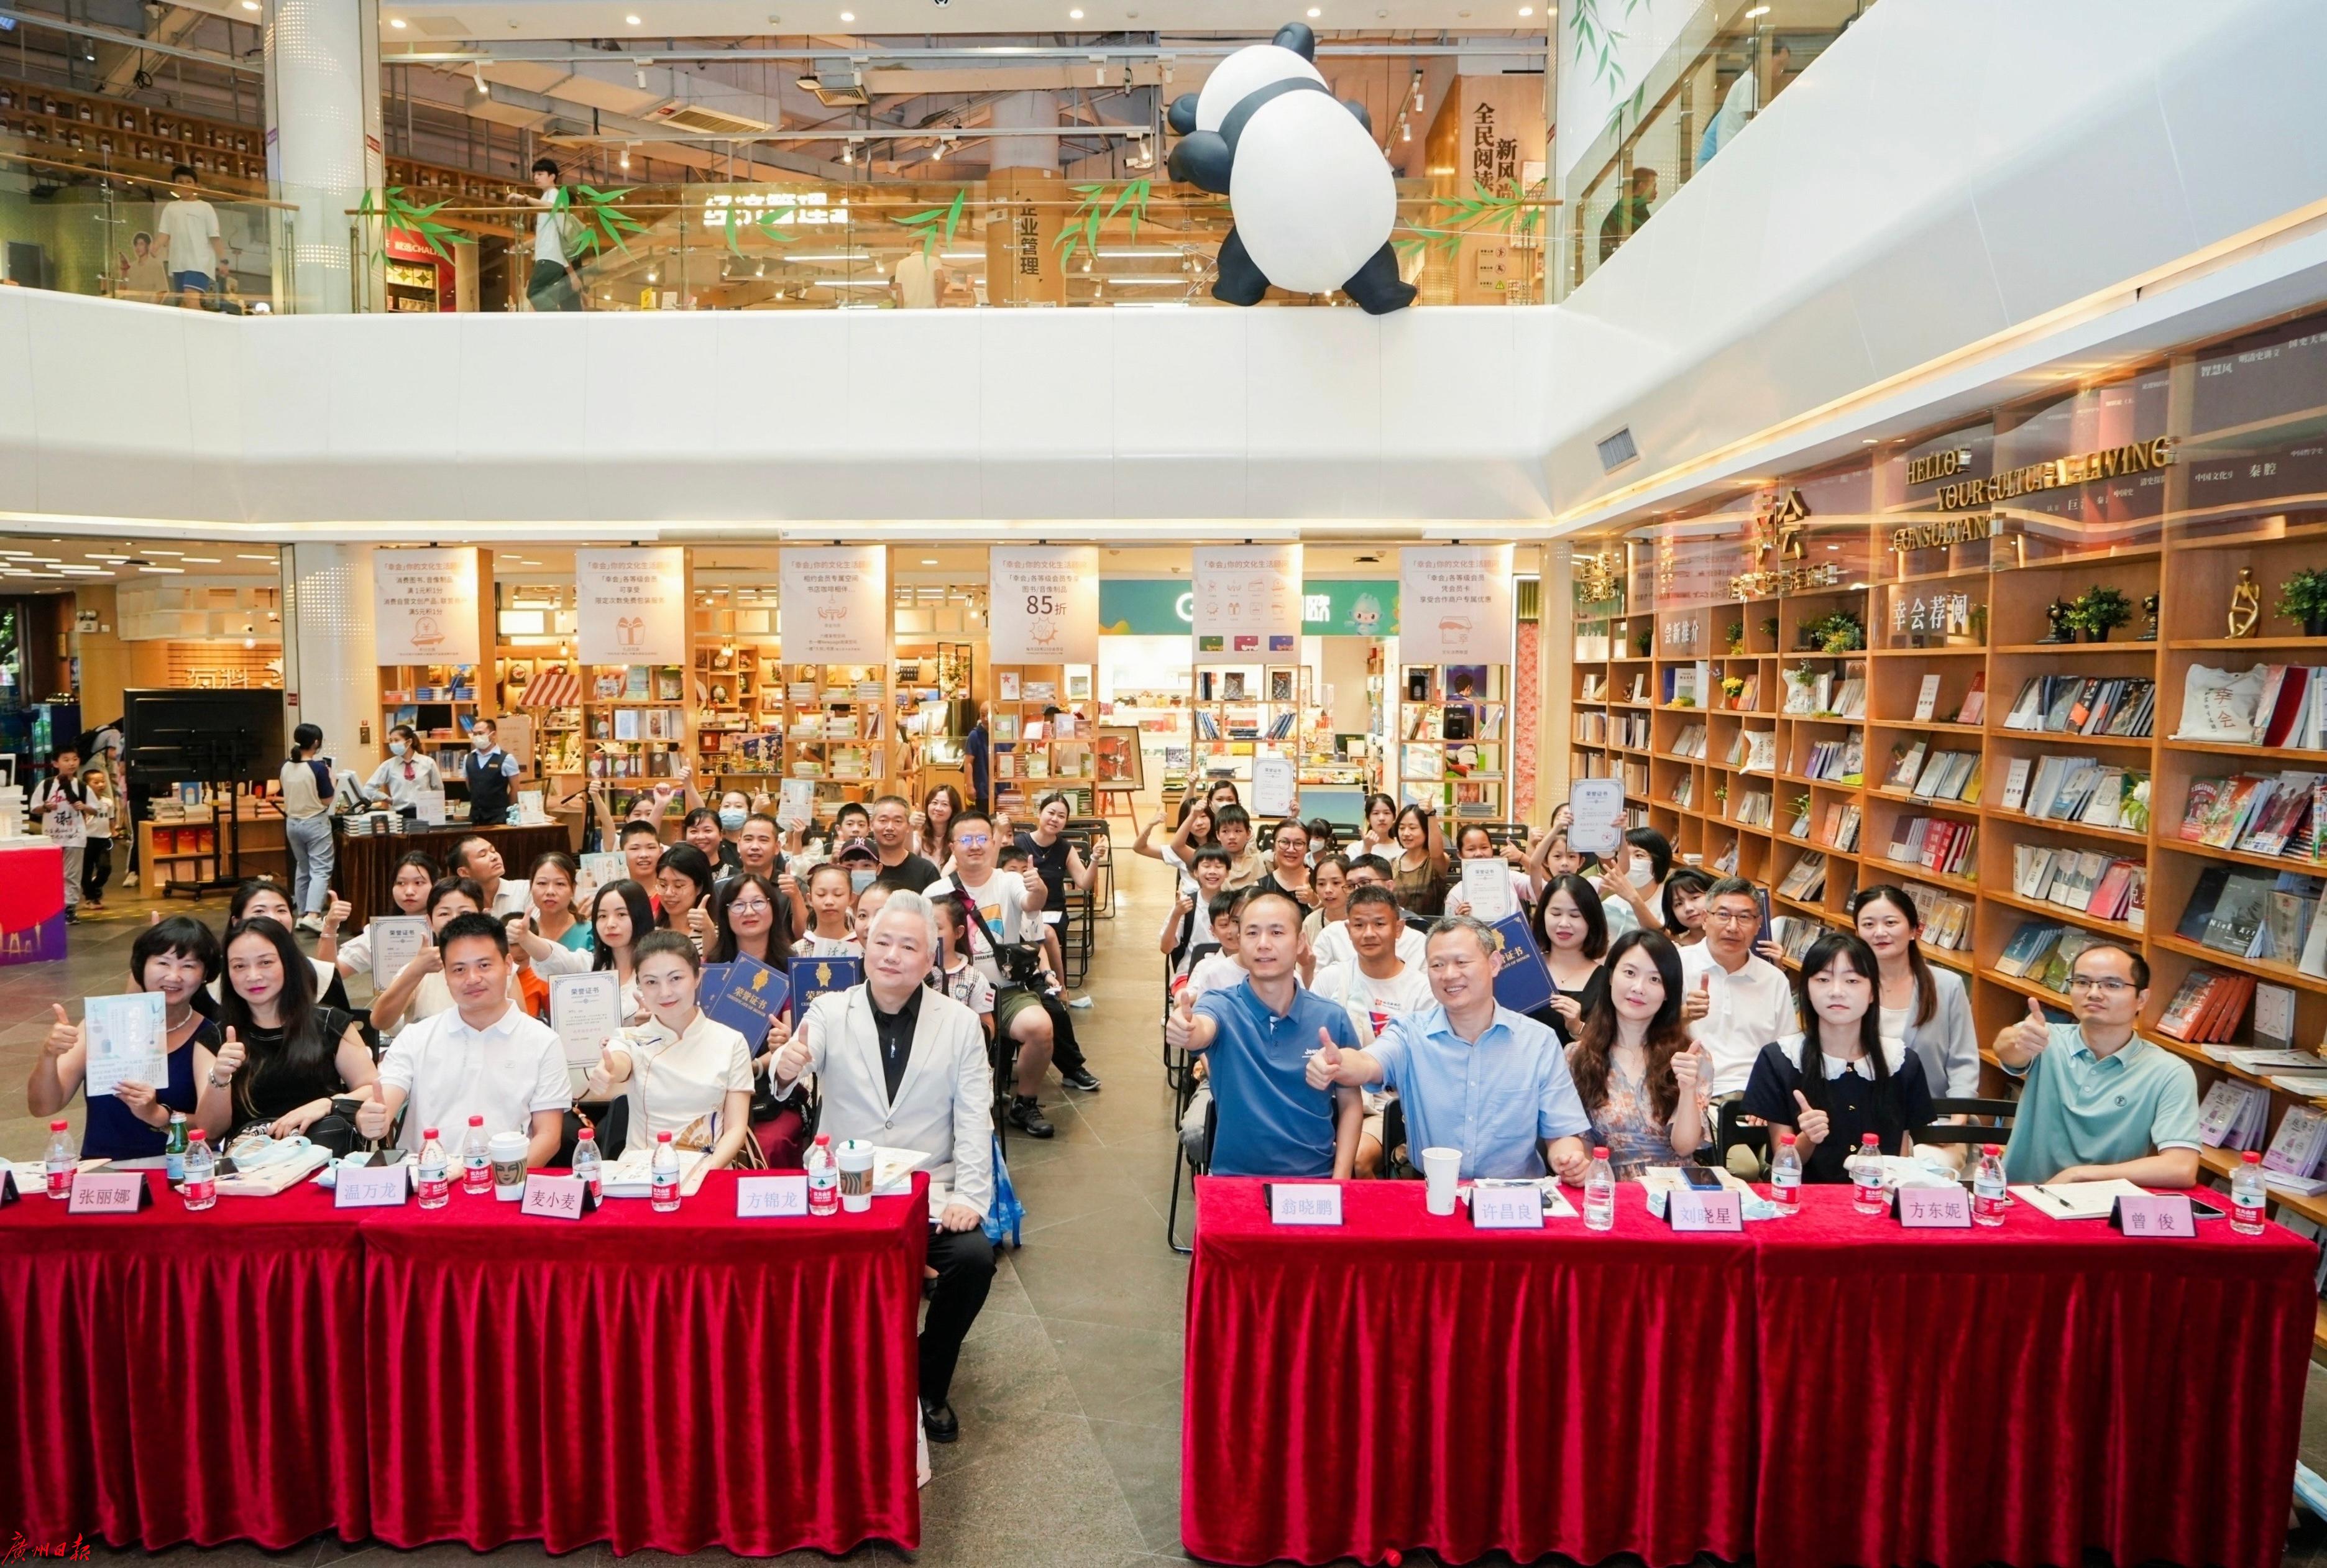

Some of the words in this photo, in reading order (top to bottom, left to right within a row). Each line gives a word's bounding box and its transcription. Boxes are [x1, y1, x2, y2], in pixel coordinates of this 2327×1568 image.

[1474, 102, 1495, 193] 全民阅读
[1495, 138, 1517, 199] 新风尚
[1020, 198, 1039, 275] 企业管理
[1935, 479, 1985, 512] YOUR
[2082, 434, 2172, 482] LIVING
[1893, 512, 1997, 552] CONSULTANT
[1026, 595, 1068, 615] 85折
[1893, 594, 1968, 631] 幸会荐阅
[1664, 620, 1700, 646] 尝新推介
[571, 986, 600, 996] 荣誉证书
[733, 985, 769, 1010] 荣誉证书
[79, 1188, 131, 1206] 张丽娜
[344, 1183, 397, 1201] 温万龙
[530, 1191, 576, 1211] 麦小麦
[746, 1191, 798, 1209] 方锦龙
[1281, 1198, 1333, 1216] 翁晓鹏
[1482, 1203, 1533, 1220] 许昌良
[1679, 1206, 1732, 1224] 刘晓星
[1909, 1202, 1962, 1220] 方东妮
